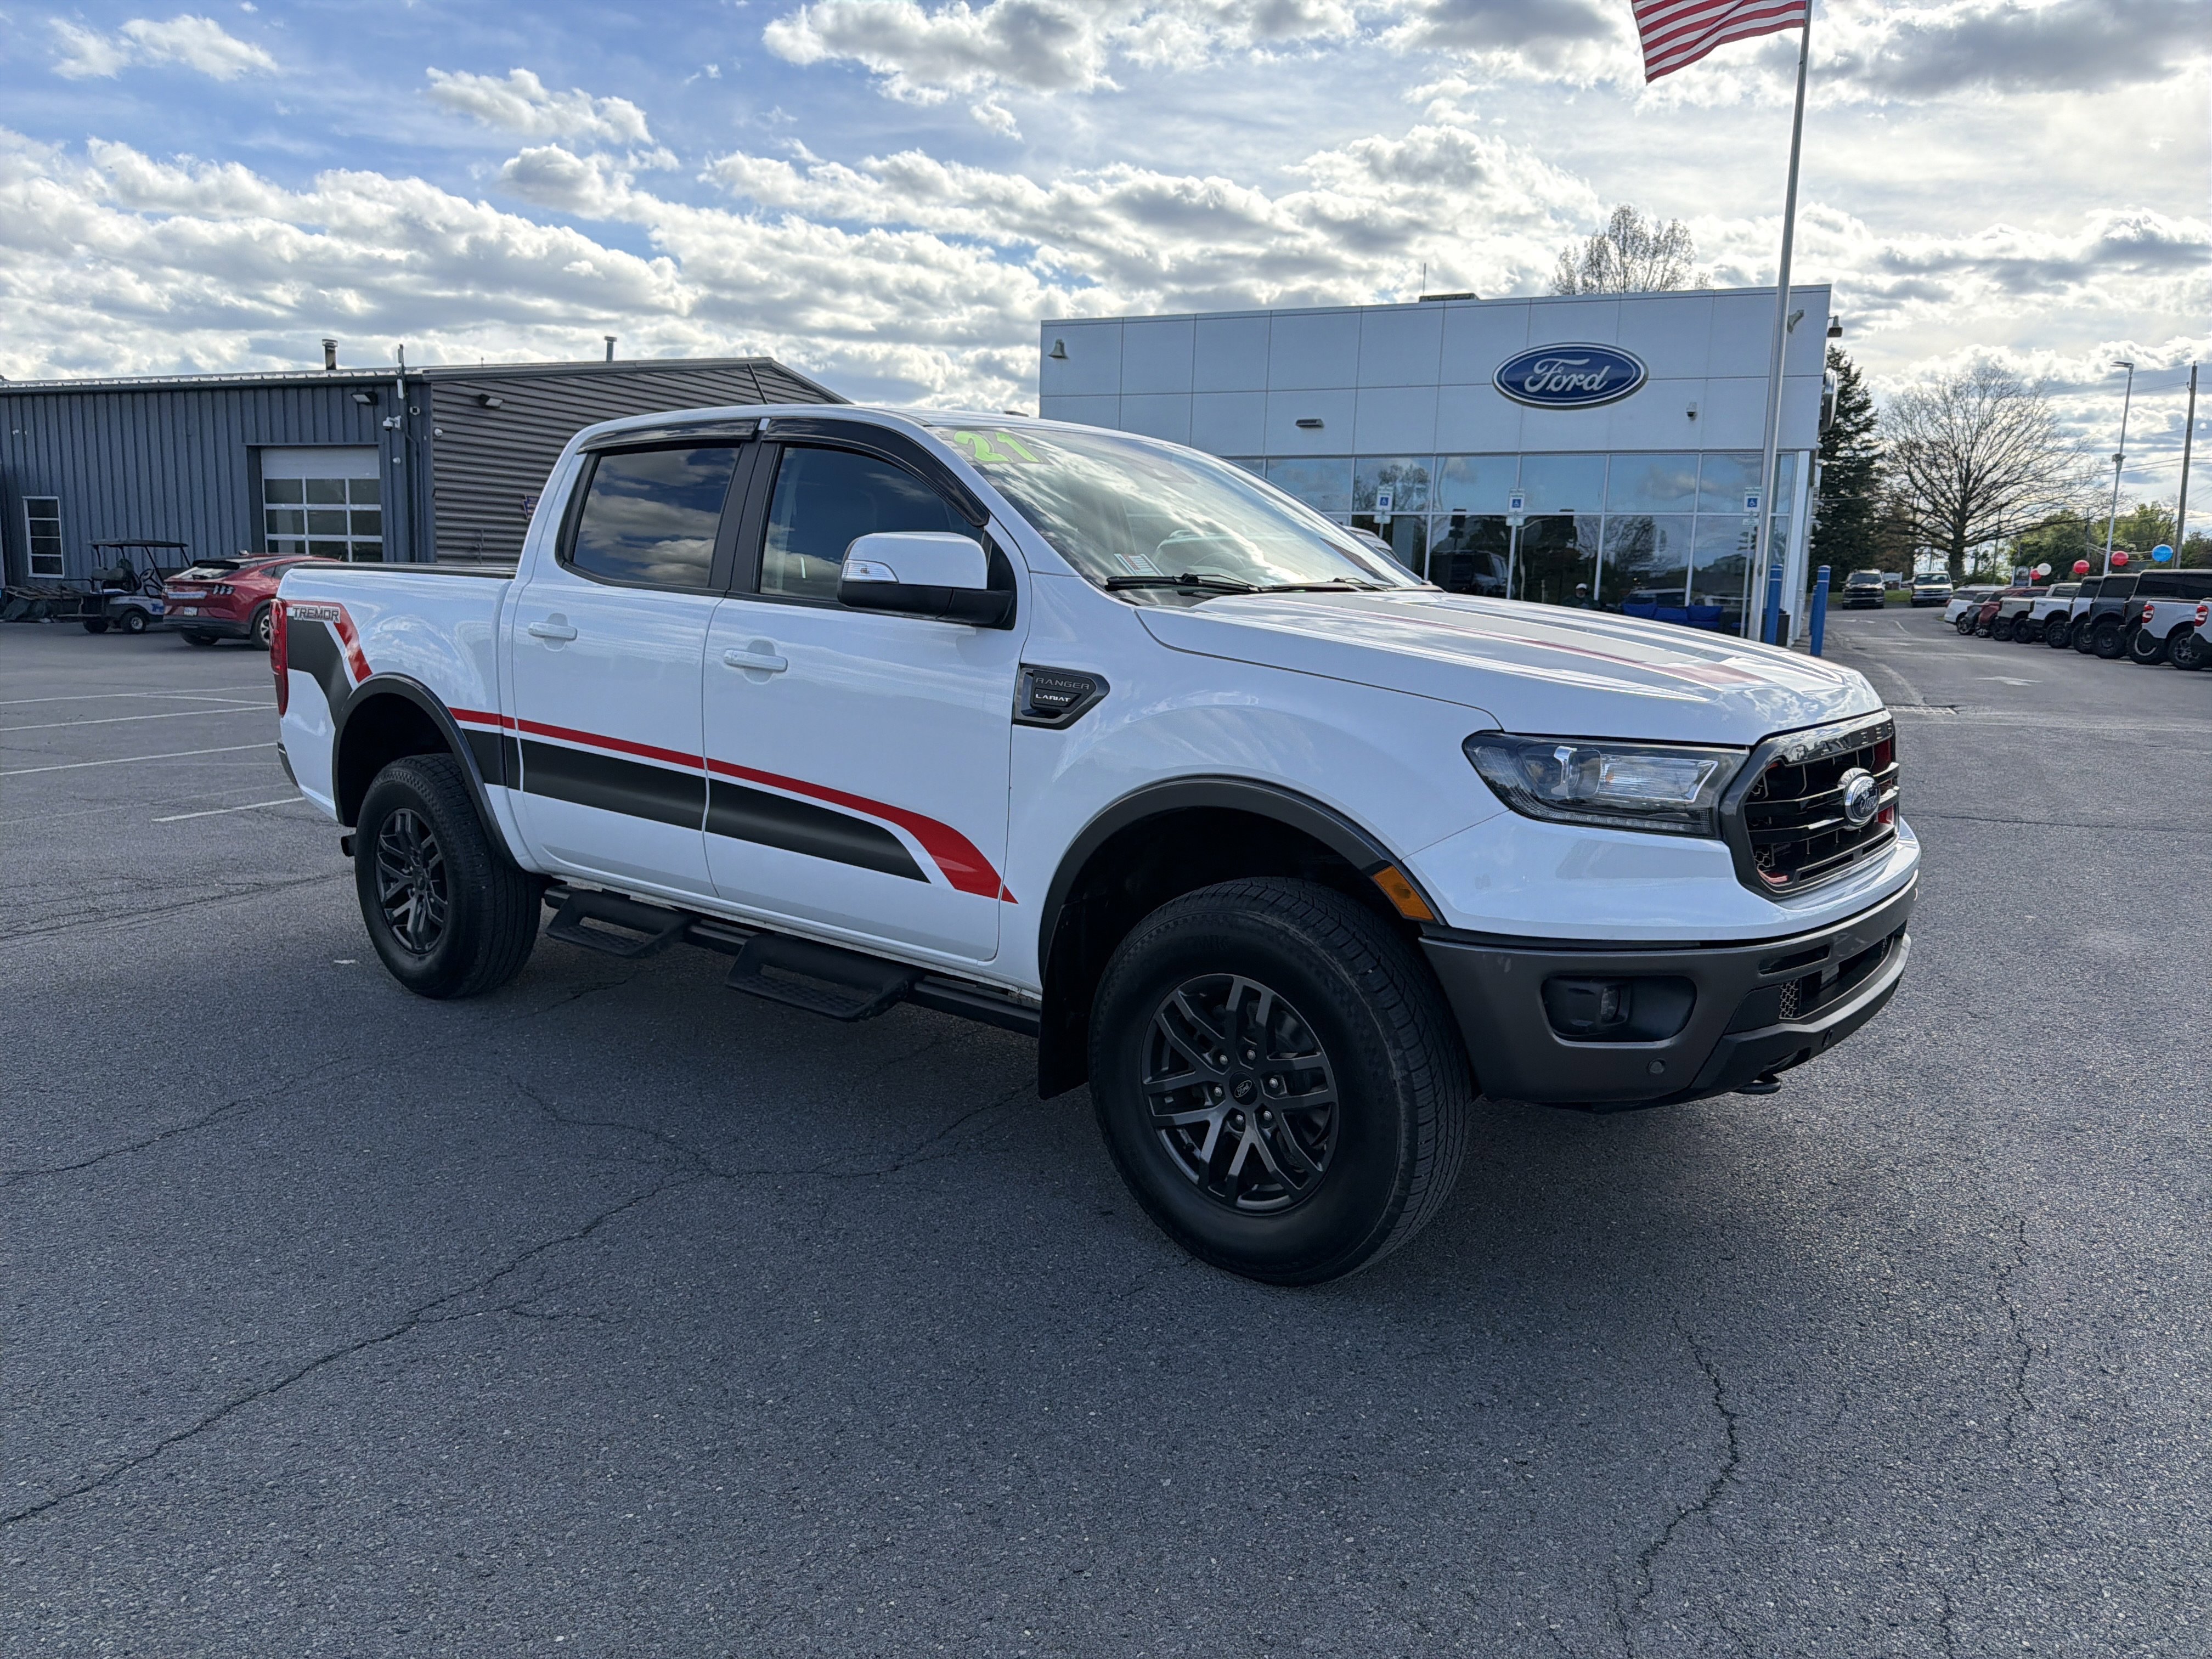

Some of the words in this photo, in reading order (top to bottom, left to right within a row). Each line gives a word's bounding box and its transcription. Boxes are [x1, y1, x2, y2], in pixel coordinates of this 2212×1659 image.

[1524, 358, 1611, 393] Ford
[953, 431, 1040, 462] 21
[292, 606, 341, 623] TREMOR
[1035, 677, 1090, 690] RANGER
[1035, 693, 1071, 702] LARIAT
[1237, 1082, 1250, 1096] Ford
